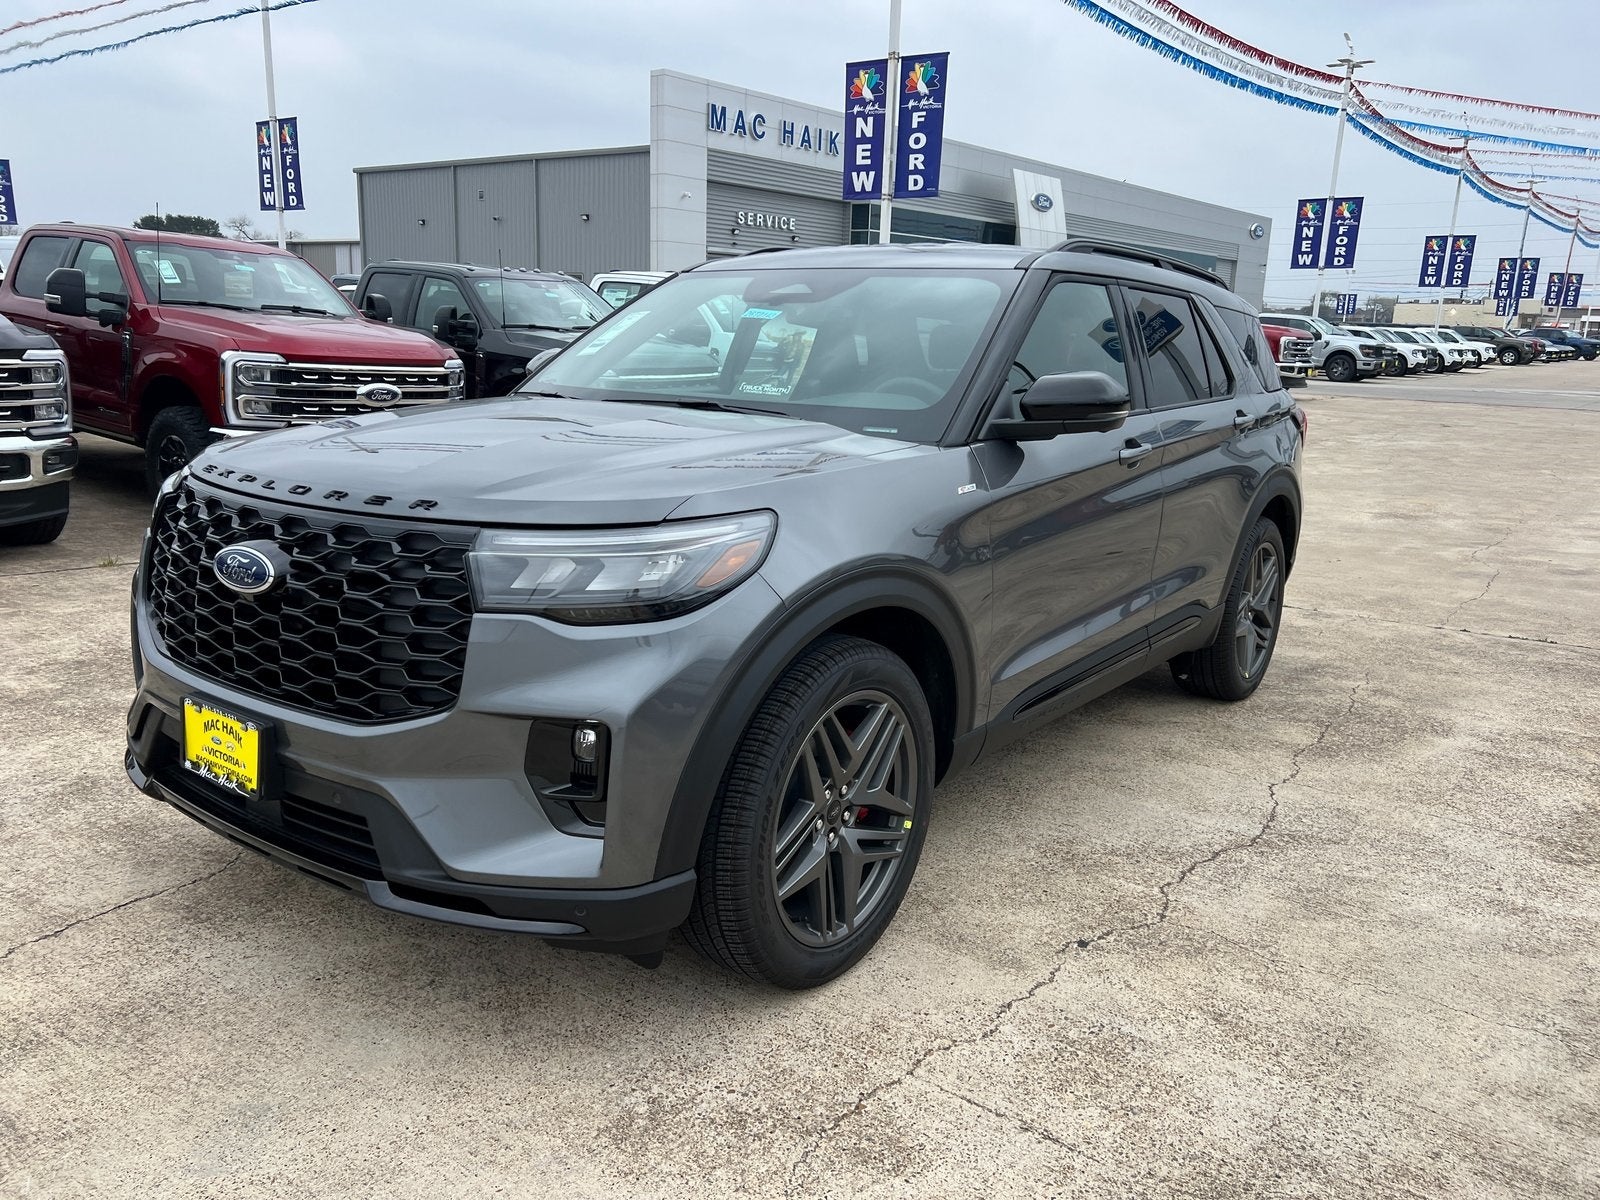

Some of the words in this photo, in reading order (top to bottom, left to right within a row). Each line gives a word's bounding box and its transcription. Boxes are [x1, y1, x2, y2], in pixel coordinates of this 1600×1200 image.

[709, 103, 766, 140] MAC
[781, 119, 840, 156] HAIK
[851, 116, 875, 192] NEW
[907, 112, 927, 191] FORD
[262, 156, 274, 206] NEW
[286, 155, 297, 206] FORD
[737, 211, 796, 230] SERVICE
[1298, 226, 1314, 266] NEW
[1333, 226, 1349, 266] FORD
[1424, 256, 1438, 285] NEW
[1452, 255, 1465, 285] FORD
[1498, 273, 1509, 297] NEW
[1521, 273, 1531, 297] FORD
[1548, 286, 1559, 305] NEW
[371, 389, 393, 401] Ford
[202, 463, 439, 511] EXPLORER
[222, 554, 257, 584] Ford
[203, 719, 220, 734] MAC
[221, 721, 243, 749] HAIK
[207, 746, 240, 768] VICTORIA
[199, 765, 218, 782] Mac
